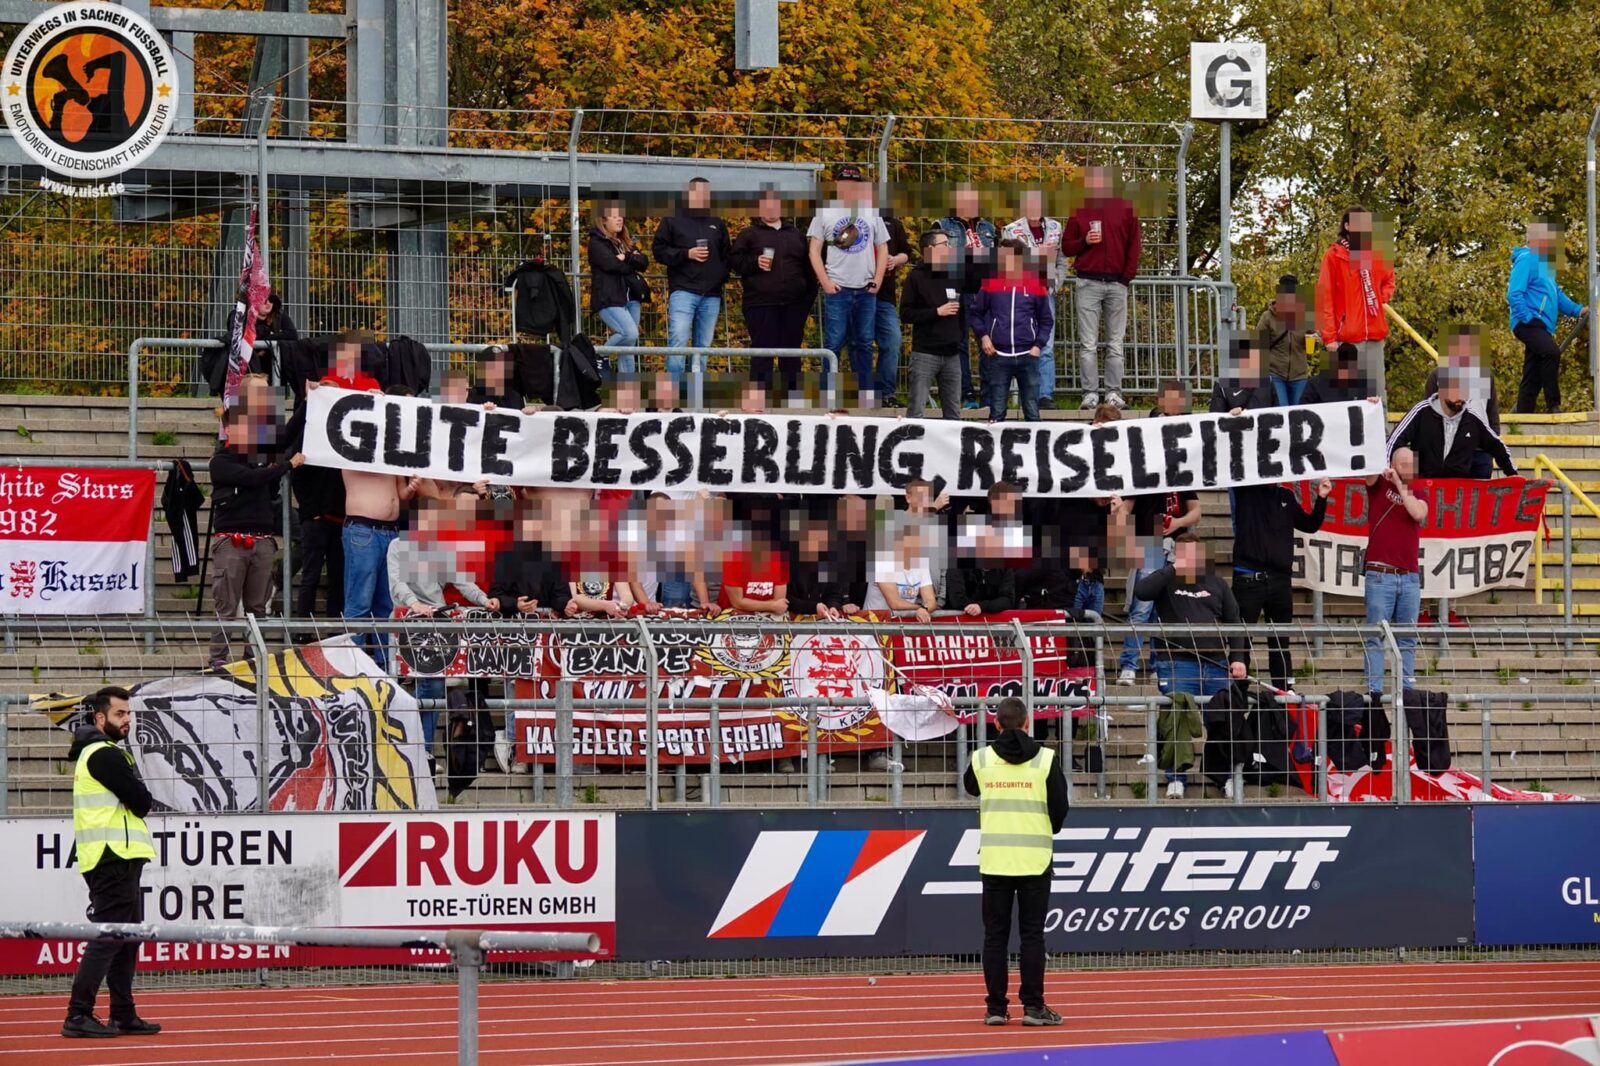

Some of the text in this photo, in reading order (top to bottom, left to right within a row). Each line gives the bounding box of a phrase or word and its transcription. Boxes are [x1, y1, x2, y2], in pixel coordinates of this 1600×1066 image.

[1205, 54, 1252, 108] G
[325, 393, 521, 475] GUTE
[957, 408, 1327, 494] REISELEITER
[0, 472, 134, 504] hite Stars
[1294, 478, 1548, 529] ED HITE
[0, 508, 58, 535] 982
[39, 560, 139, 600] Kassel
[1432, 540, 1532, 590] 1982
[526, 722, 784, 757] KASELER SPORTEREIN
[37, 822, 293, 869] HTÜREN
[405, 819, 599, 887] RUKU
[407, 895, 597, 917] TORE-TÜREN GMBH
[1561, 876, 1600, 906] GL
[1043, 905, 1311, 933] OGISTICS GROUP
